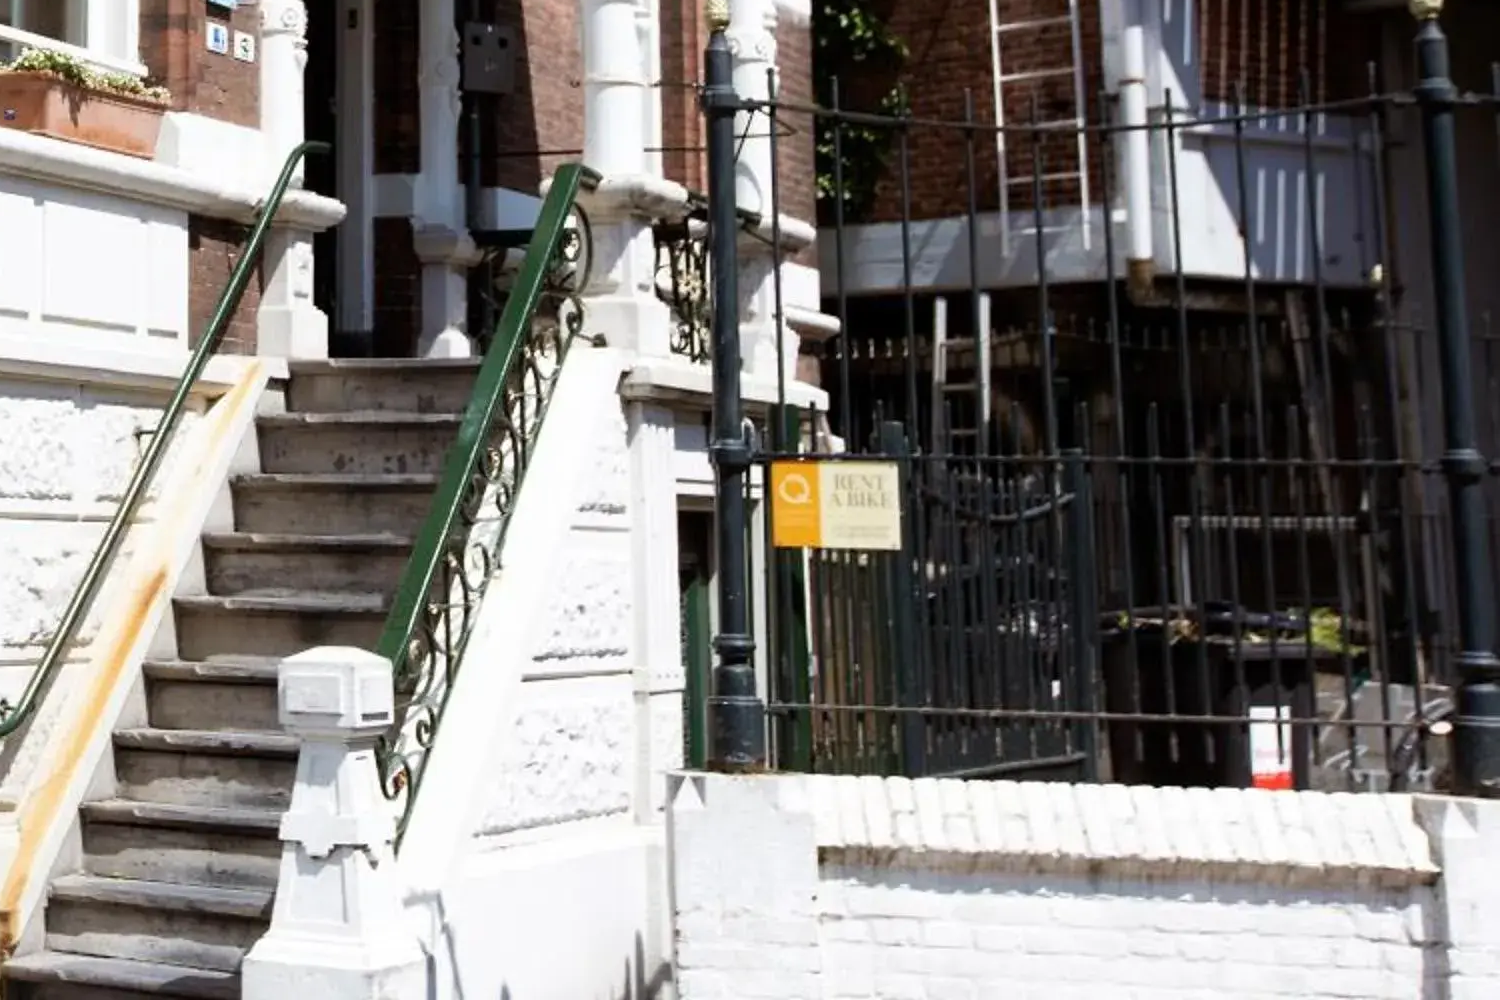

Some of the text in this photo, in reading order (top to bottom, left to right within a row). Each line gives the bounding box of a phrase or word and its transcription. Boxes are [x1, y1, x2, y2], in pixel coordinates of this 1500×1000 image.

[834, 474, 884, 491] RENT
[831, 491, 891, 508] A BIKE
